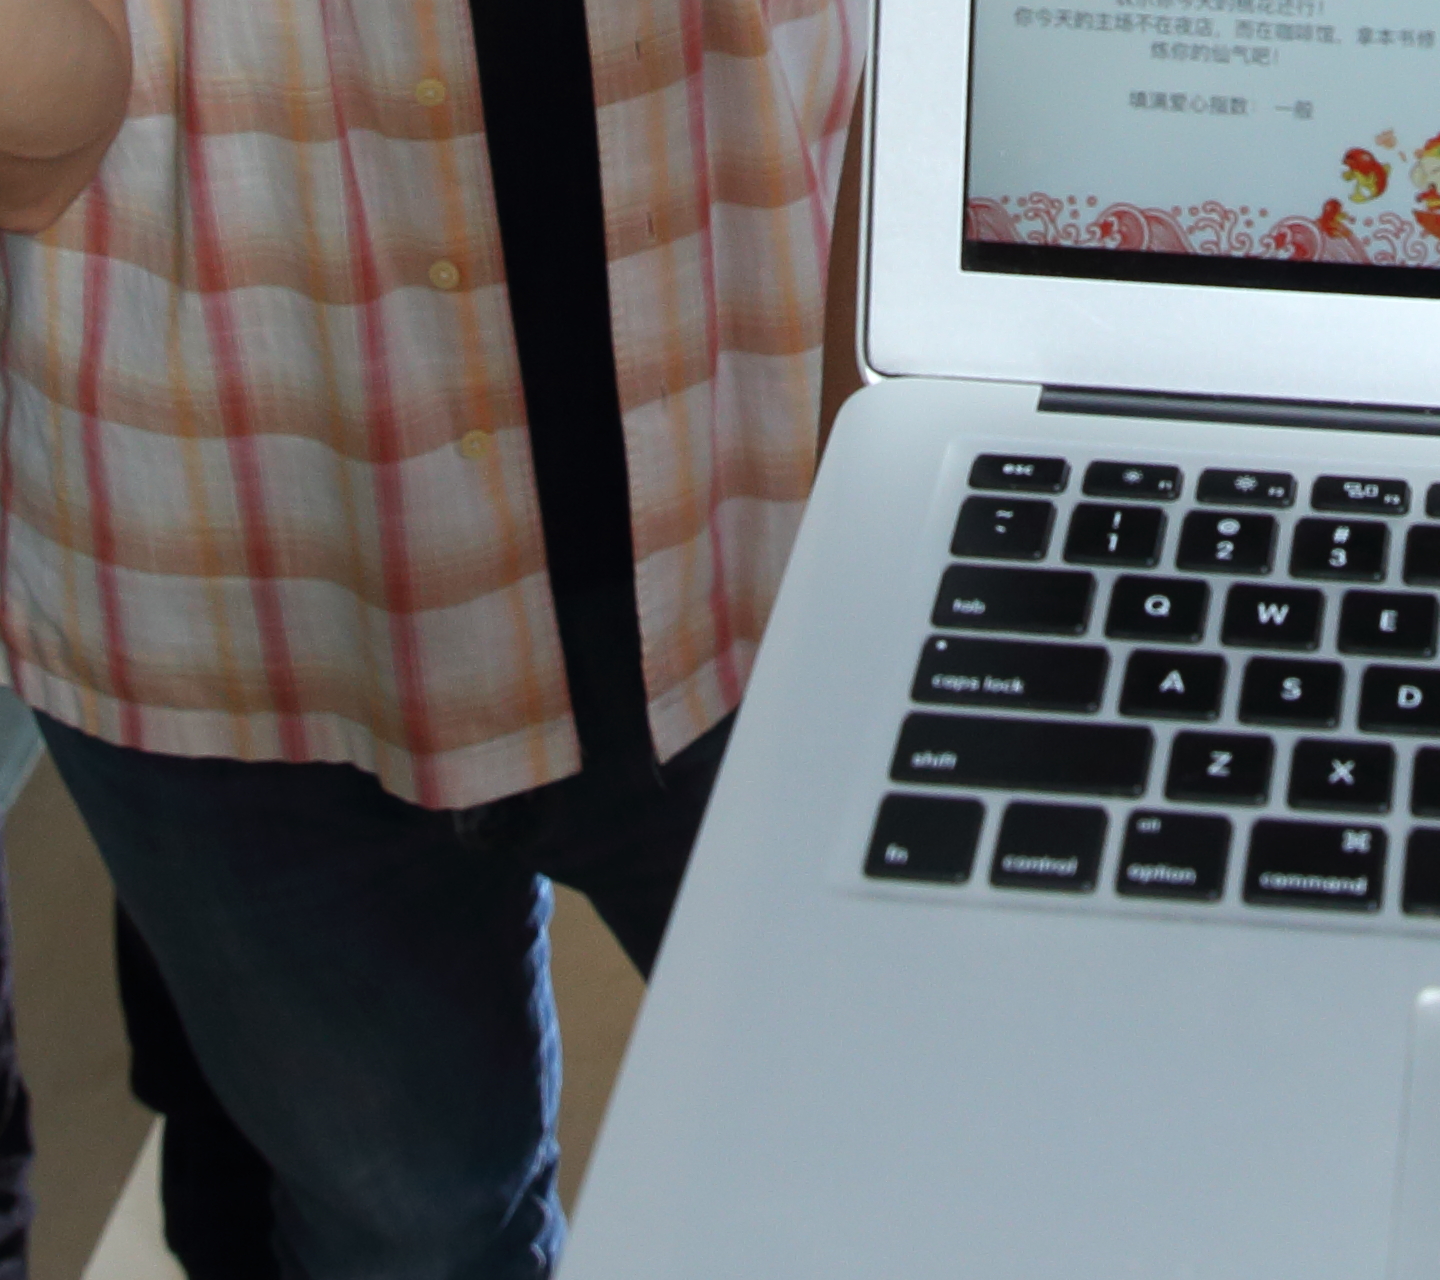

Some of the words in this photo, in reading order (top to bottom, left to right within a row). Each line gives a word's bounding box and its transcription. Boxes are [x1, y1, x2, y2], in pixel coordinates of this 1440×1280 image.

[1107, 533, 1118, 552] 1
[1216, 541, 1234, 561] 2
[1329, 549, 1347, 568] 3
[1144, 595, 1171, 617] Q
[1257, 603, 1289, 625] W
[1379, 611, 1397, 631] E
[1160, 670, 1185, 694] A
[1281, 677, 1302, 701] S
[1397, 685, 1423, 708] D
[1207, 751, 1232, 776] Z
[1329, 760, 1355, 785] X
[1002, 854, 1077, 876] control
[1127, 864, 1196, 885] option
[1259, 870, 1369, 896] command
